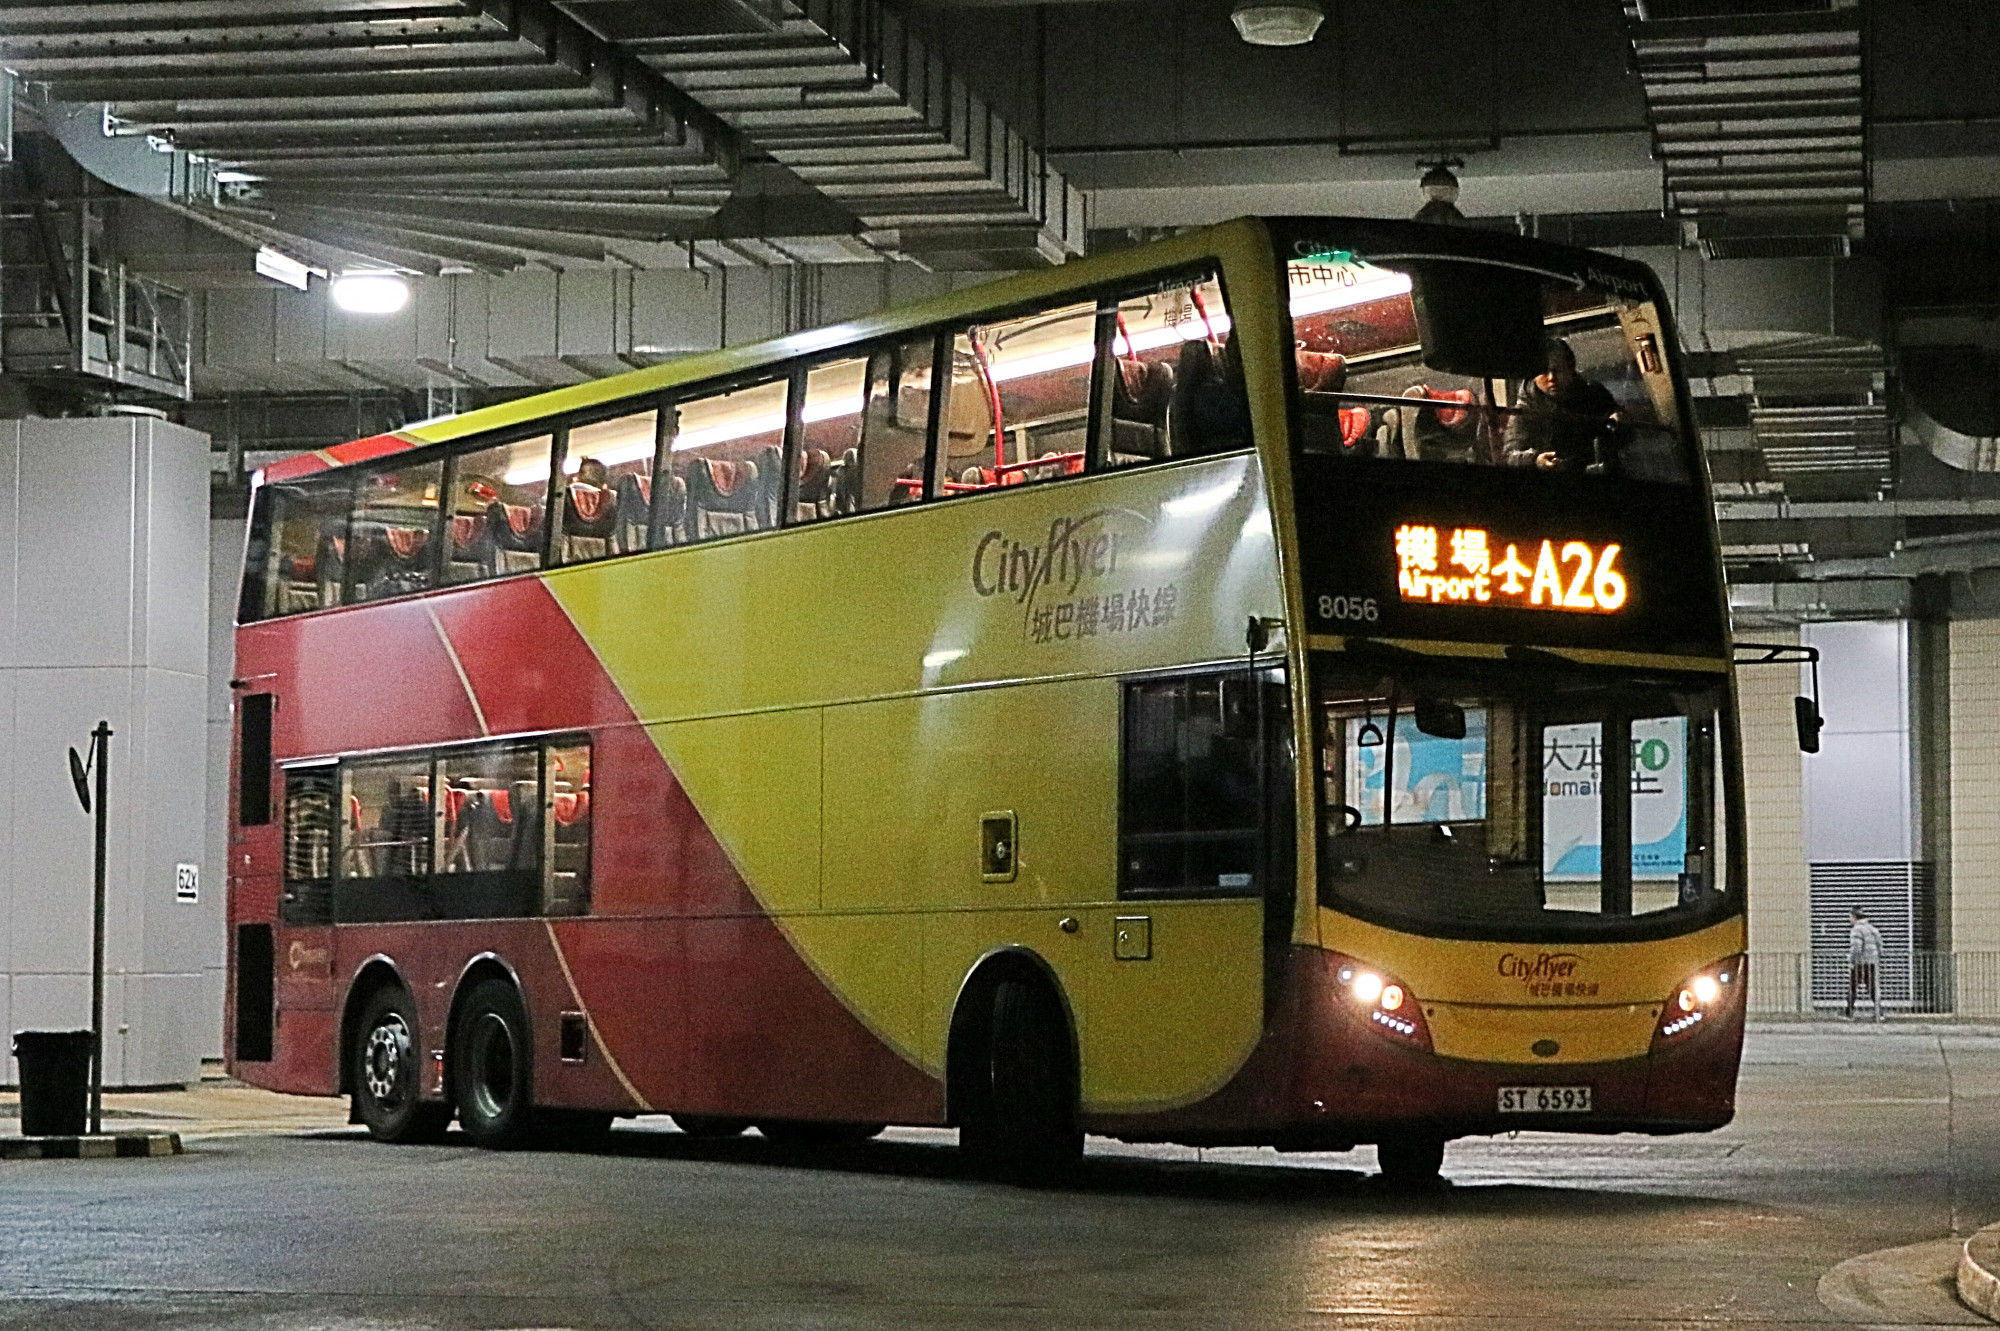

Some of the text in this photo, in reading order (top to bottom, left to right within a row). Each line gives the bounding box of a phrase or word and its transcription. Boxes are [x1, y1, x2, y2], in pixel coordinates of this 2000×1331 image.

[1287, 264, 1358, 287] 市中心
[1396, 525, 1490, 574] 機場
[1399, 570, 1490, 602] Airport
[1531, 540, 1627, 610] A26
[1318, 595, 1378, 621] 8056
[1503, 1089, 1587, 1109] ST 6593
